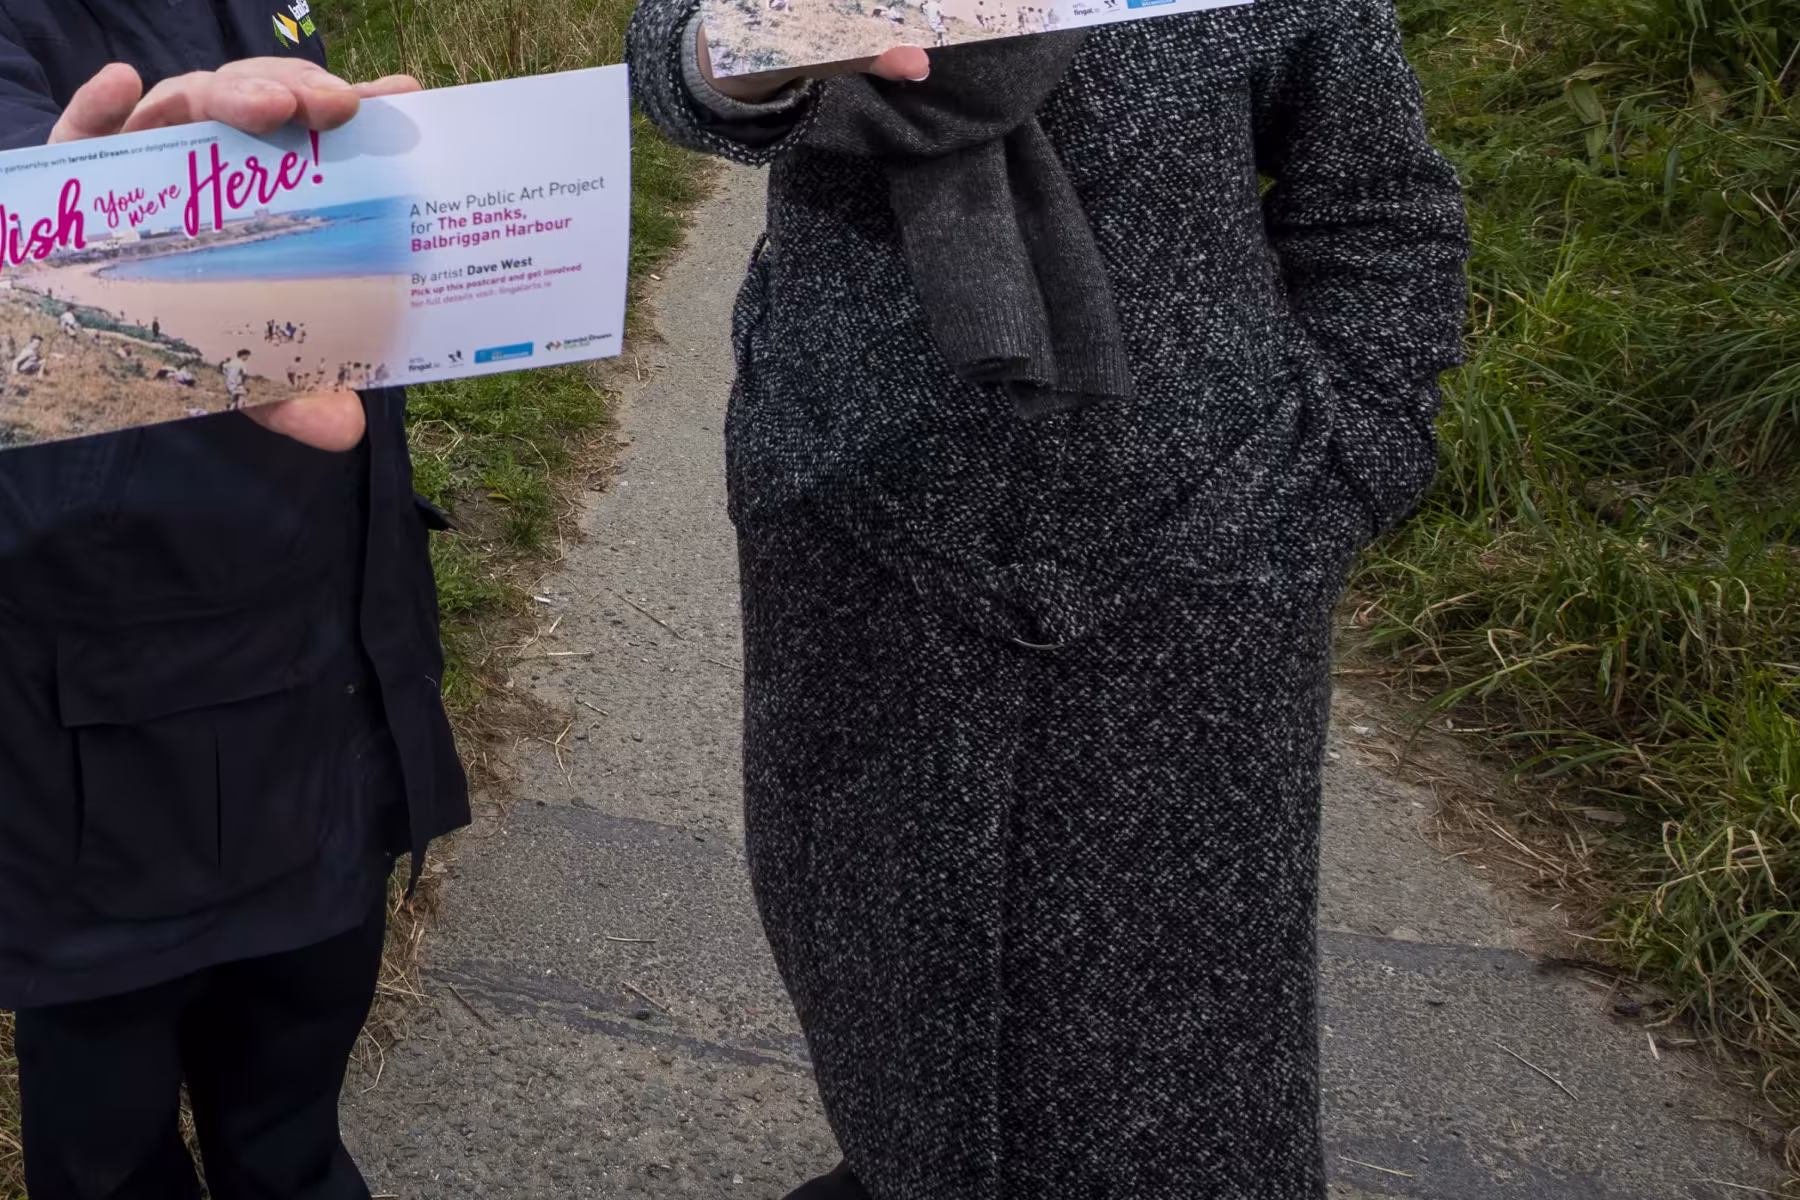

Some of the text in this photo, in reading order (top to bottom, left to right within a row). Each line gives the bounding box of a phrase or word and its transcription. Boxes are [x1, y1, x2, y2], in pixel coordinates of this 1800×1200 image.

[4, 161, 49, 175] partnership
[50, 158, 67, 166] with
[145, 141, 179, 153] delighted
[94, 187, 145, 228] You
[184, 131, 323, 238] Here!
[410, 176, 605, 218] A New Public Art Project
[410, 207, 528, 235] for The Banks,
[411, 217, 573, 252] Balbriggan Harbour
[410, 263, 582, 297] Pick up this postcard and get involved
[411, 256, 533, 286] By artist Dave West
[442, 292, 473, 303] details
